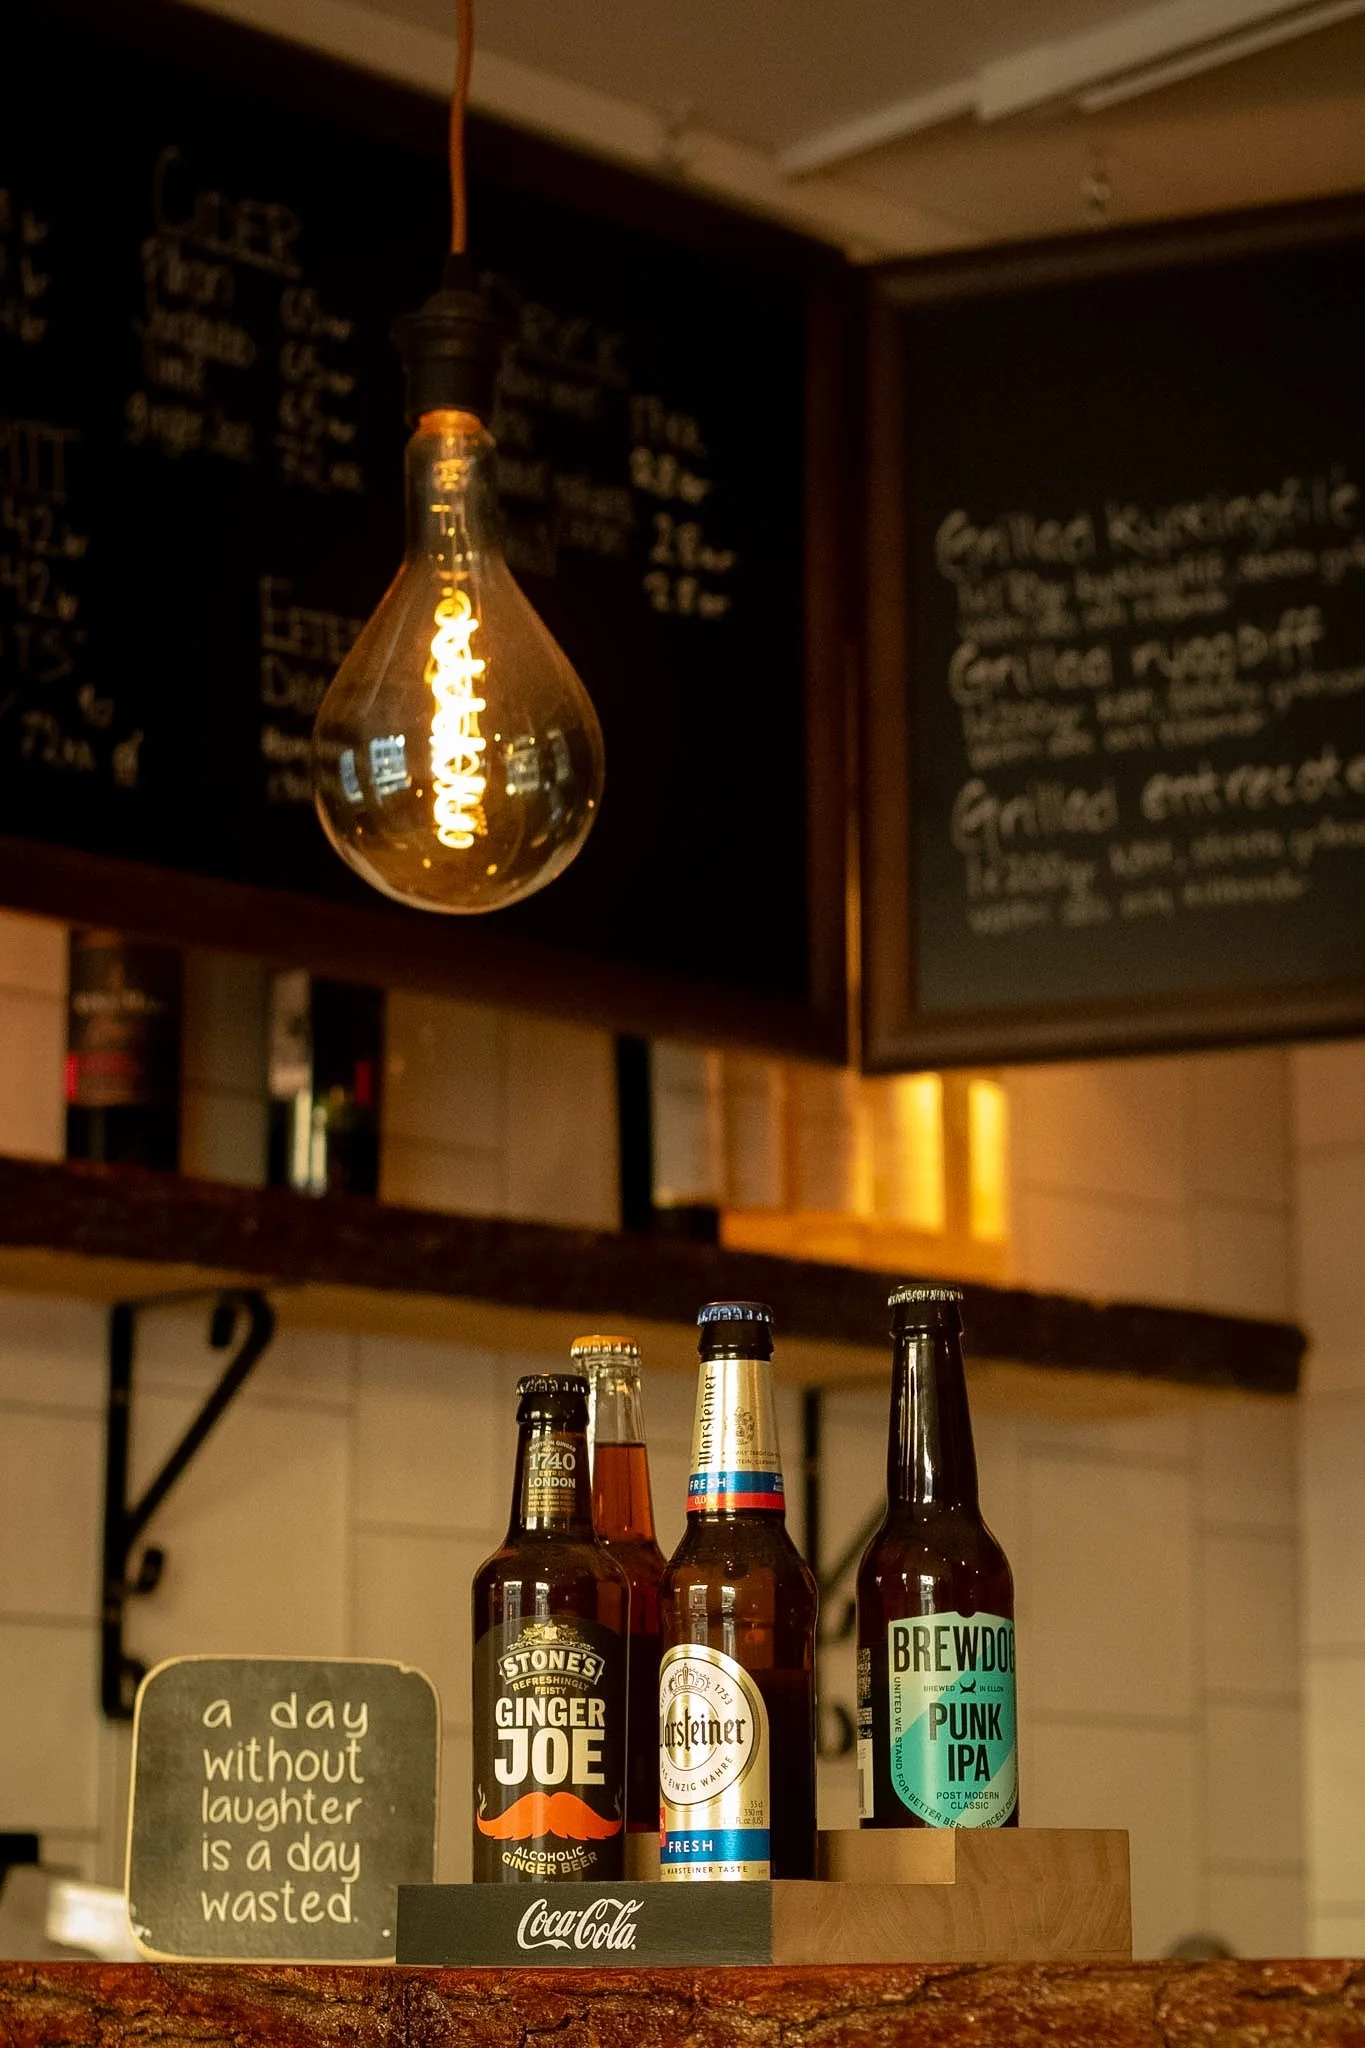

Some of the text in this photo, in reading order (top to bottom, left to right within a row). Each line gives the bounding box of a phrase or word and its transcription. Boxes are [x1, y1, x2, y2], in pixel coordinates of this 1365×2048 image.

[935, 508, 1096, 582] Grilled
[948, 640, 1113, 708] Grilled
[950, 777, 1119, 856] Grilled
[529, 1453, 576, 1471] 1740
[528, 1477, 576, 1488] LONDON
[689, 1477, 726, 1491] FRESH
[503, 1649, 597, 1676] STONE'S
[512, 1675, 590, 1692] REFRESHINGLY
[534, 1686, 566, 1695] FEISTY
[714, 1682, 733, 1706] 1753
[893, 1676, 902, 1714] UNITED
[203, 1692, 368, 1738] a day
[495, 1697, 606, 1727] GINGER
[894, 1717, 902, 1733] WE
[929, 1702, 1003, 1741] PUNK
[203, 1736, 365, 1783] without
[494, 1728, 605, 1785] JOE
[894, 1736, 903, 1770] STAND
[948, 1744, 991, 1782] IPA
[668, 1778, 697, 1792] EINZIG
[700, 1756, 733, 1787] WAHRE
[896, 1773, 910, 1796] FOR
[202, 1787, 363, 1832] laughter
[908, 1793, 942, 1824] BETTER
[936, 1791, 1000, 1801] POST MODERN
[950, 1801, 989, 1810] CLASSIC
[202, 1831, 361, 1883] is a day
[514, 1846, 585, 1862] ALCOHOLIC
[668, 1839, 713, 1853] FRESH
[501, 1851, 598, 1875] GINGER BEER
[667, 1866, 713, 1875] WARSTEINER
[718, 1865, 749, 1874] TASTE
